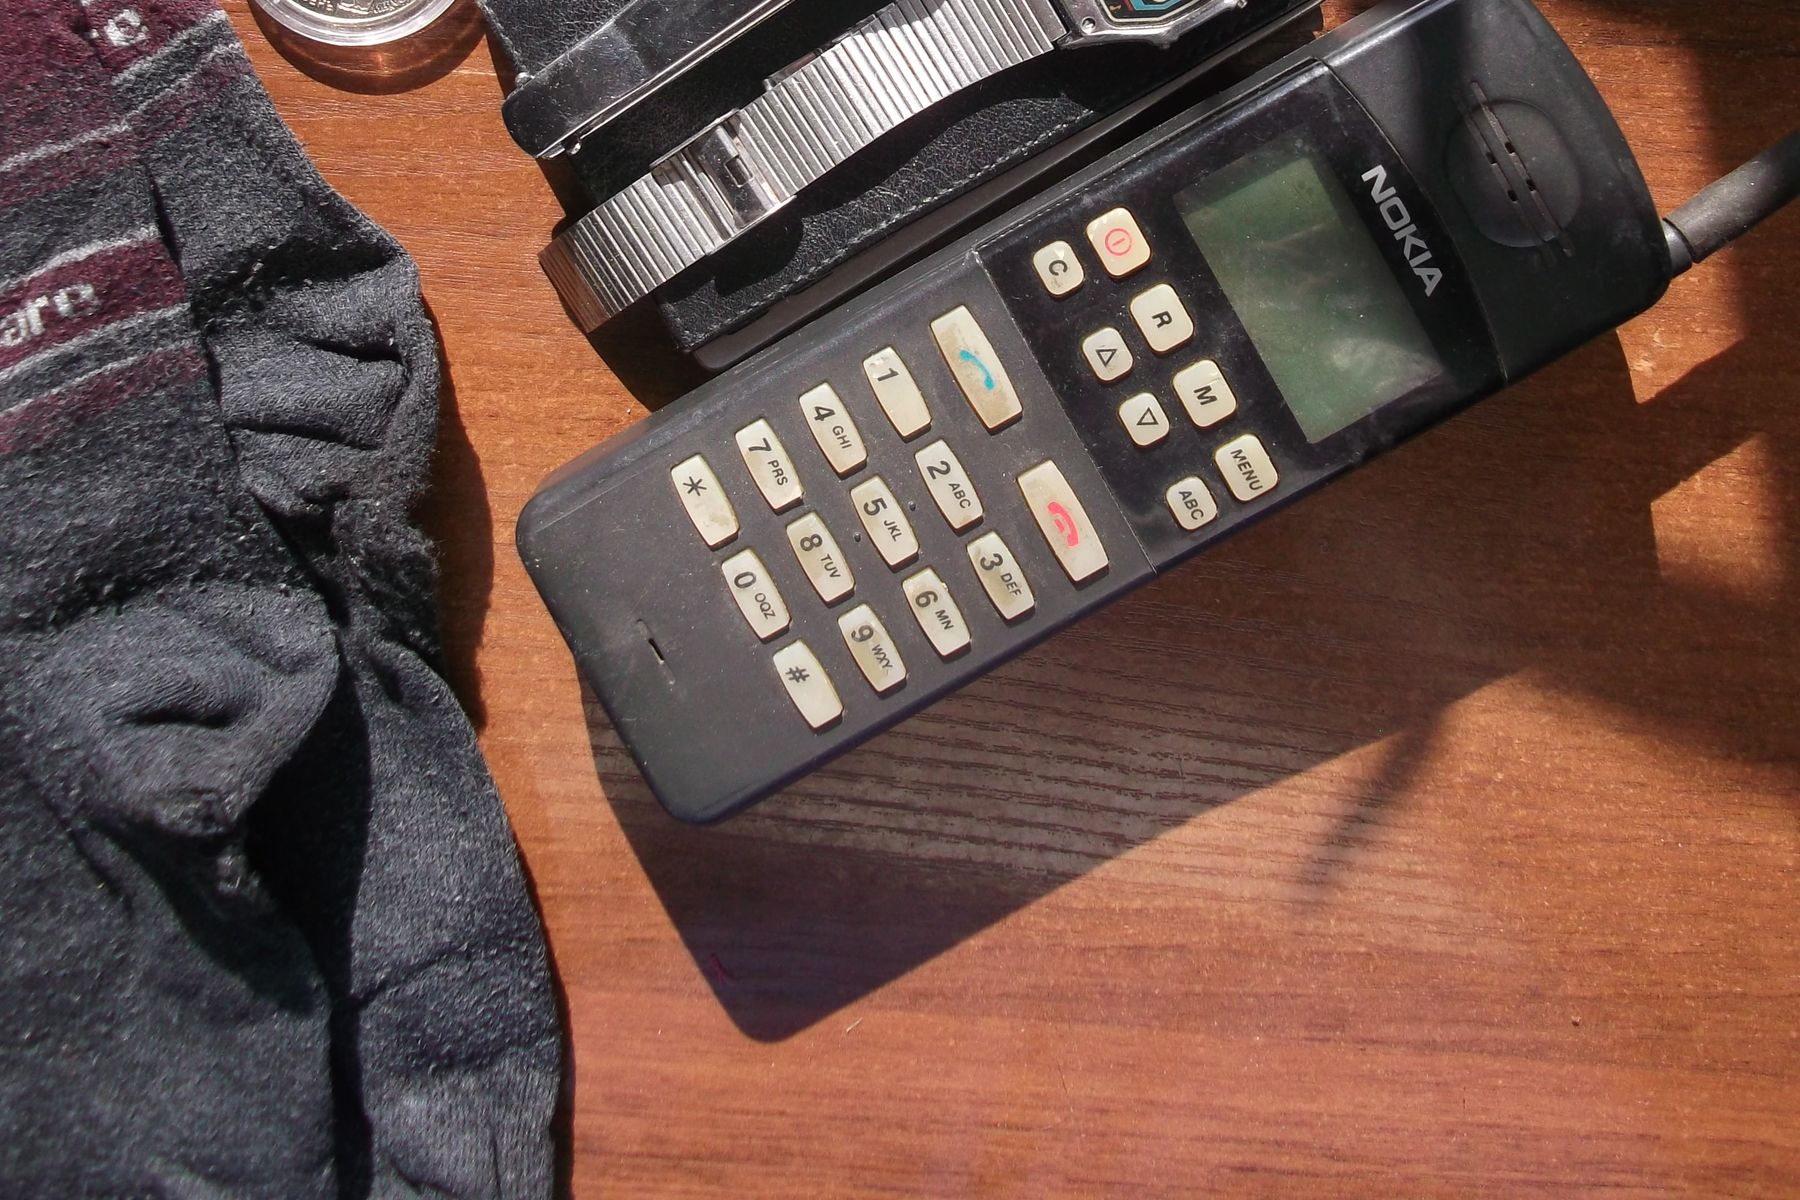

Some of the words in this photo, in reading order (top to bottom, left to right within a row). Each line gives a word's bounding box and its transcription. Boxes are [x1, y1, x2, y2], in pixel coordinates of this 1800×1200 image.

[1361, 164, 1443, 298] NOKIA
[1048, 259, 1068, 276] C
[1151, 310, 1173, 328] R
[876, 366, 899, 382] 1
[1193, 385, 1217, 406] M
[813, 406, 836, 422] 4
[832, 425, 852, 449] GHI
[748, 437, 772, 453] 7
[767, 459, 788, 486] PRS
[1230, 448, 1263, 491] MENU
[926, 460, 951, 480] 2
[948, 481, 972, 510] ABC
[1178, 490, 1204, 521] ABC
[863, 497, 888, 517] 5
[883, 518, 904, 543] JKL
[800, 533, 823, 552] 8
[820, 553, 841, 579] TUV
[979, 553, 1004, 572] 3
[1000, 571, 1023, 597] DEF
[733, 571, 757, 589] 0
[754, 592, 776, 620] OQZ
[914, 589, 938, 608] 6
[934, 609, 954, 631] MN
[851, 624, 874, 643] 9
[871, 642, 893, 671] WXY
